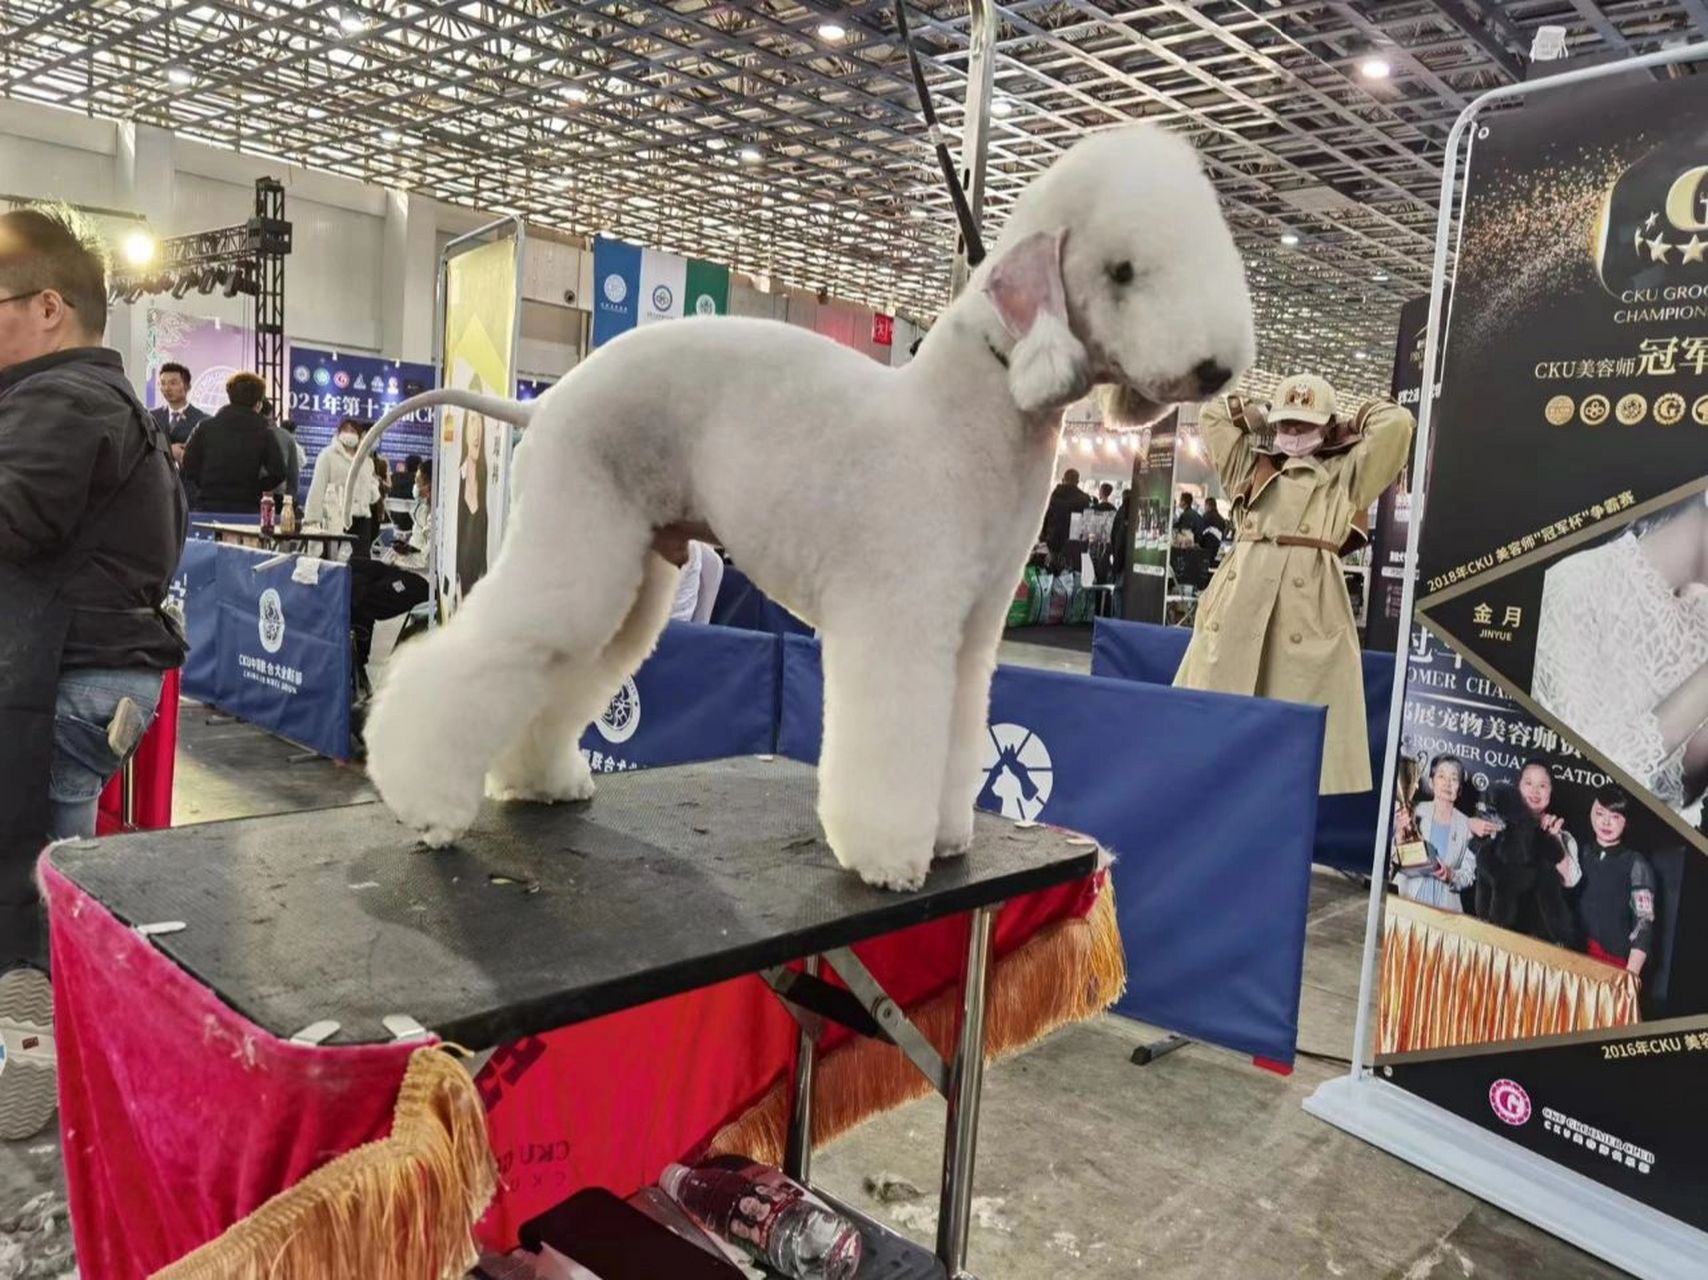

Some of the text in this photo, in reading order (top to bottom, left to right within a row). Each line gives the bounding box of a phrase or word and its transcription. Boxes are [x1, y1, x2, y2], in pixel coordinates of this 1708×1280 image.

[1621, 287, 1659, 304] CKU
[1427, 554, 1494, 593] 2018年CKU
[1479, 629, 1513, 641] JINYUE
[1466, 676, 1513, 700] CHA
[1601, 1037, 1682, 1060] 2016年CKU
